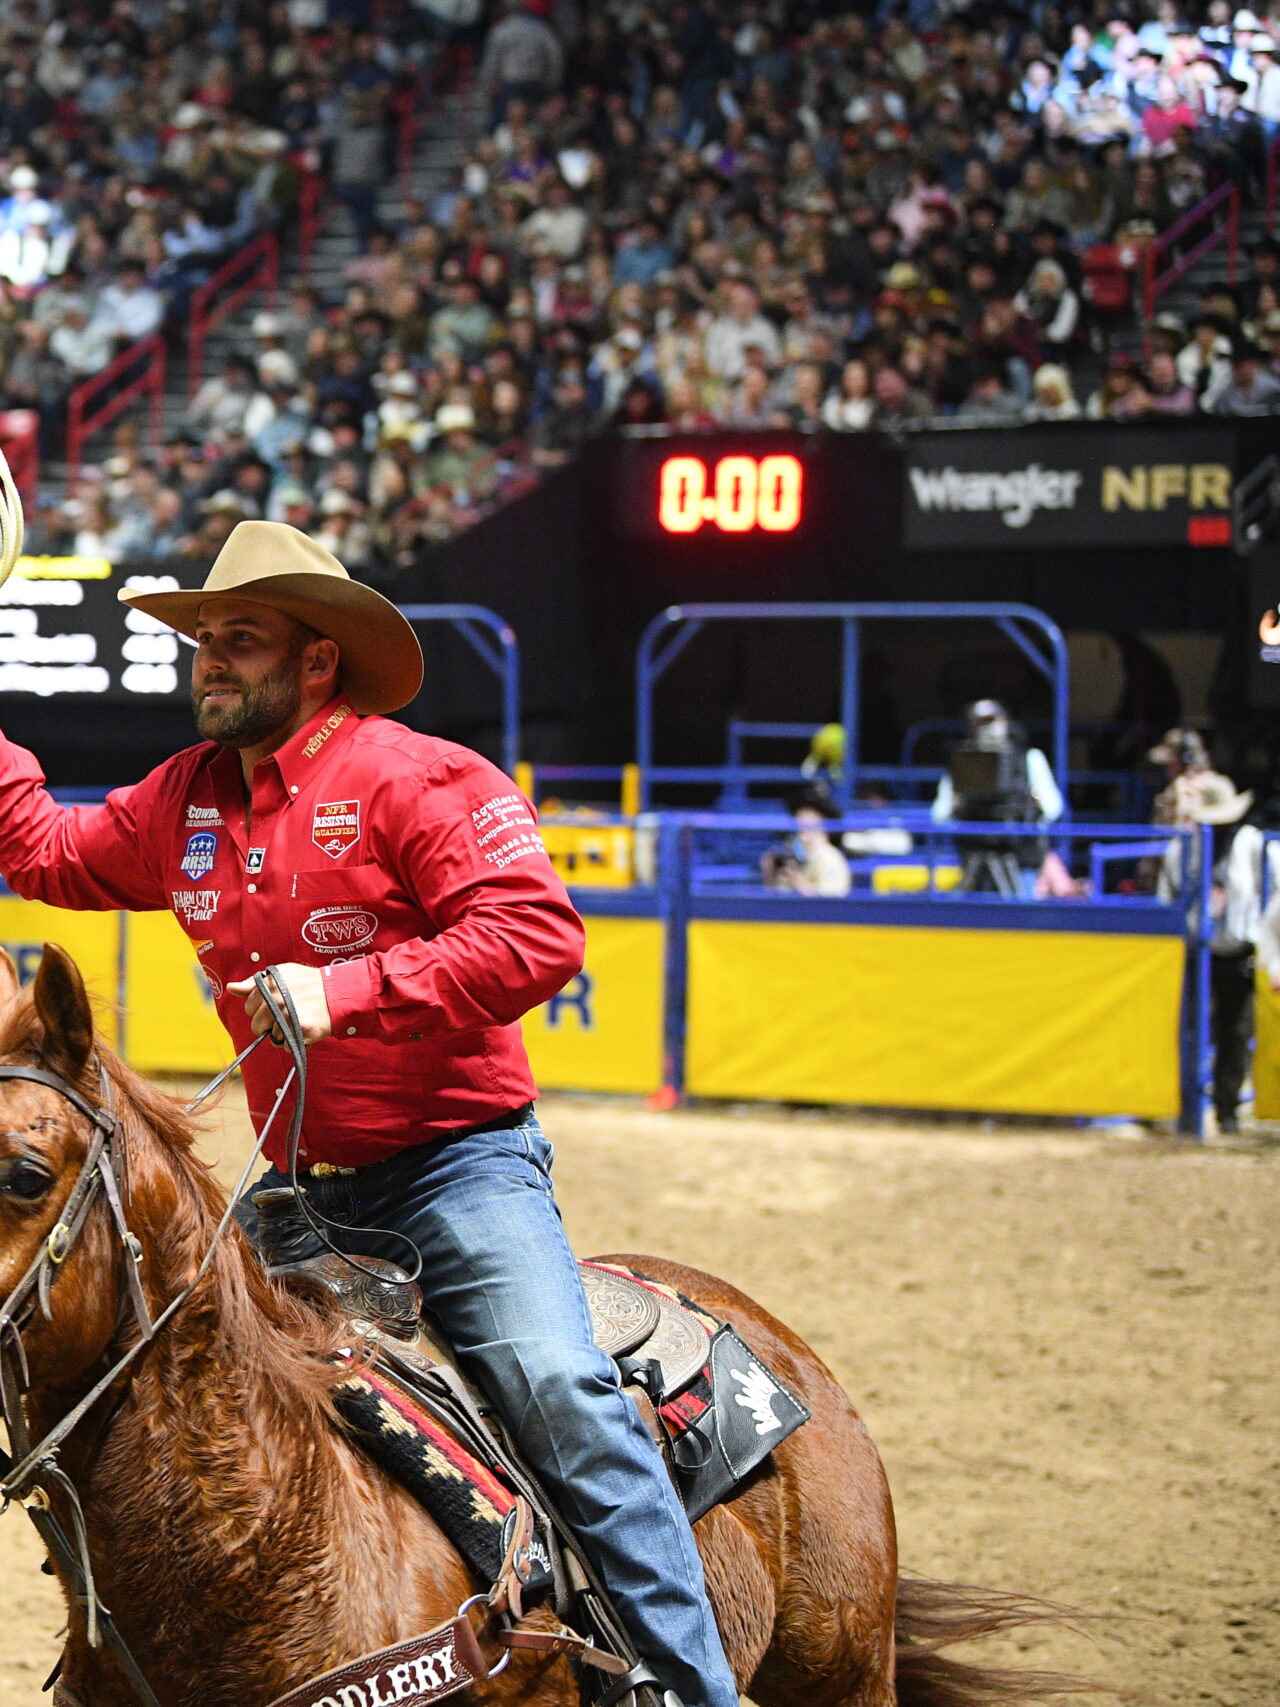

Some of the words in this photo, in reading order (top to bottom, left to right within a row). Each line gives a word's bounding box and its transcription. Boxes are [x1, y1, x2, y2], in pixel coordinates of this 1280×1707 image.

[909, 463, 1081, 528] Wrangler
[1101, 464, 1232, 512] NFR
[325, 805, 348, 815] NFR
[471, 795, 519, 822] Aguilera
[314, 814, 357, 828] RESISTOL
[315, 827, 357, 837] QUALIFIER
[172, 891, 195, 913] FARM
[196, 890, 222, 912] CITY
[310, 915, 369, 942] TWS
